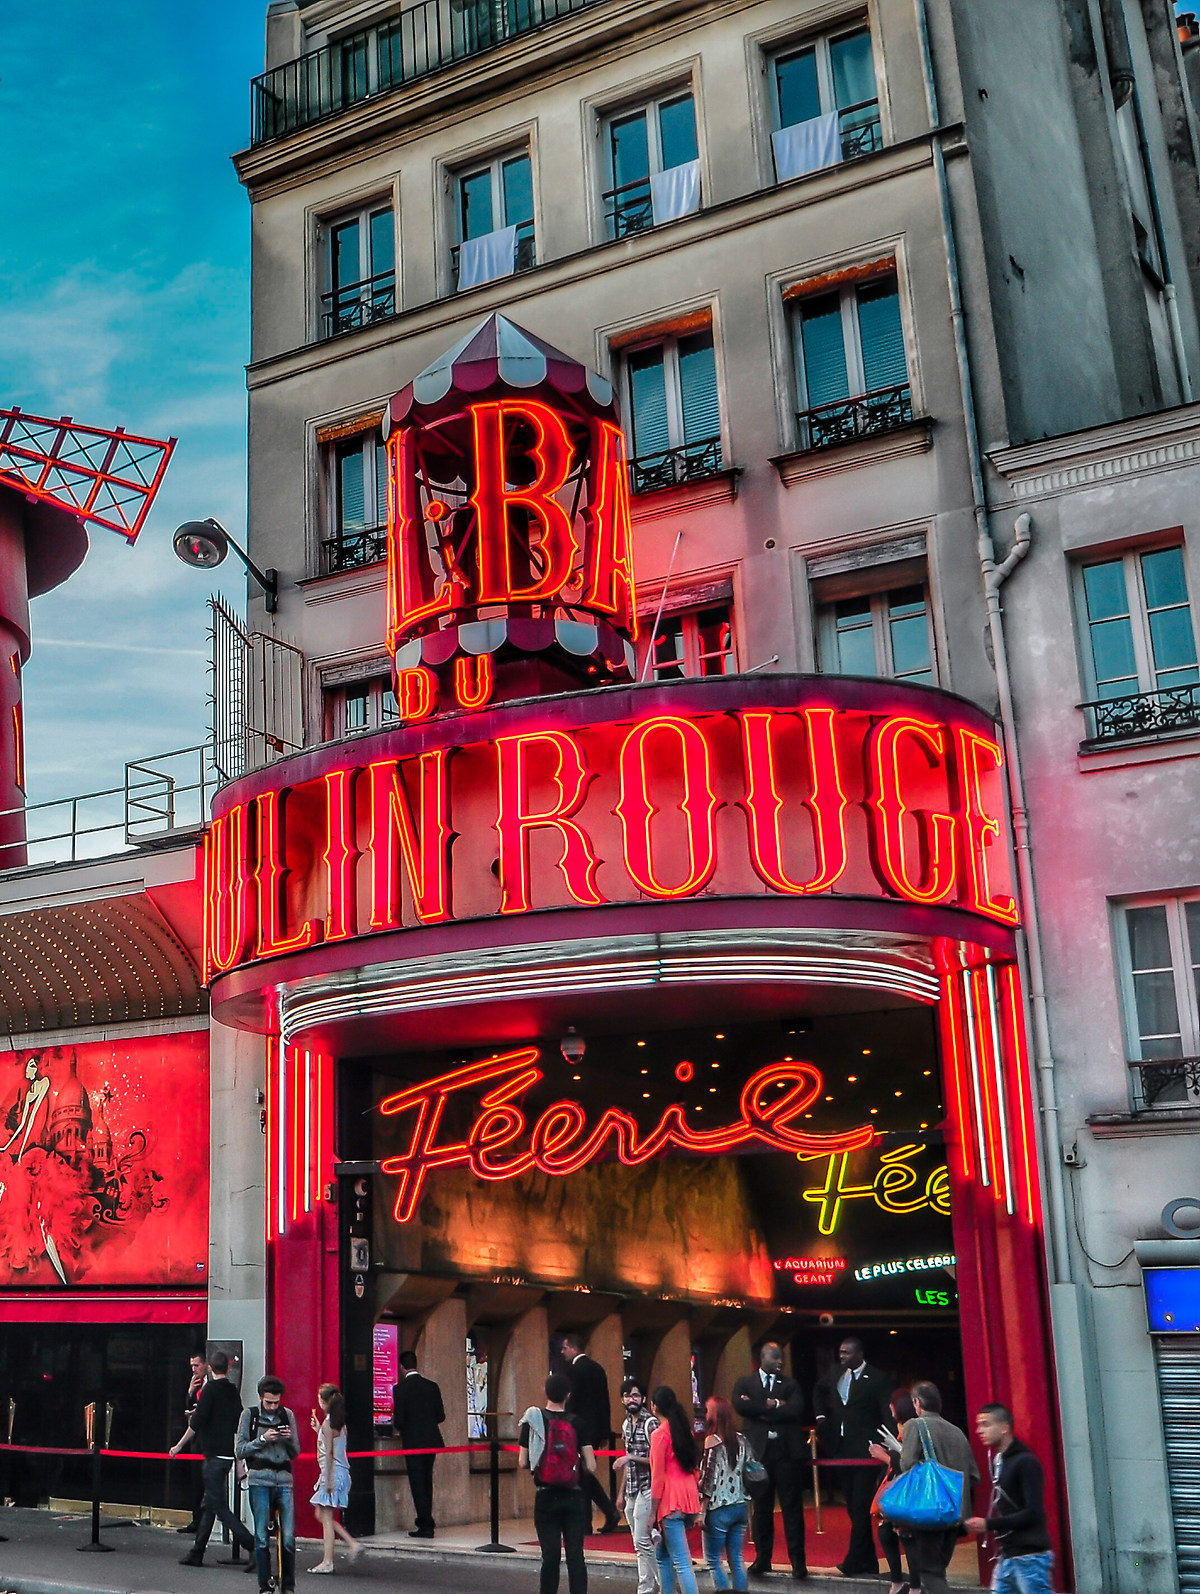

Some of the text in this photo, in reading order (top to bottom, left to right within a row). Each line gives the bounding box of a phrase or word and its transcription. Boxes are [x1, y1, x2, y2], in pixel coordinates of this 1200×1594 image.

[398, 654, 494, 721] DU
[494, 706, 1021, 926] ROUGE
[379, 1045, 877, 1224] Féerie
[853, 1267, 873, 1282] LE
[872, 1260, 906, 1278] PLUS
[914, 1288, 950, 1306] LES
